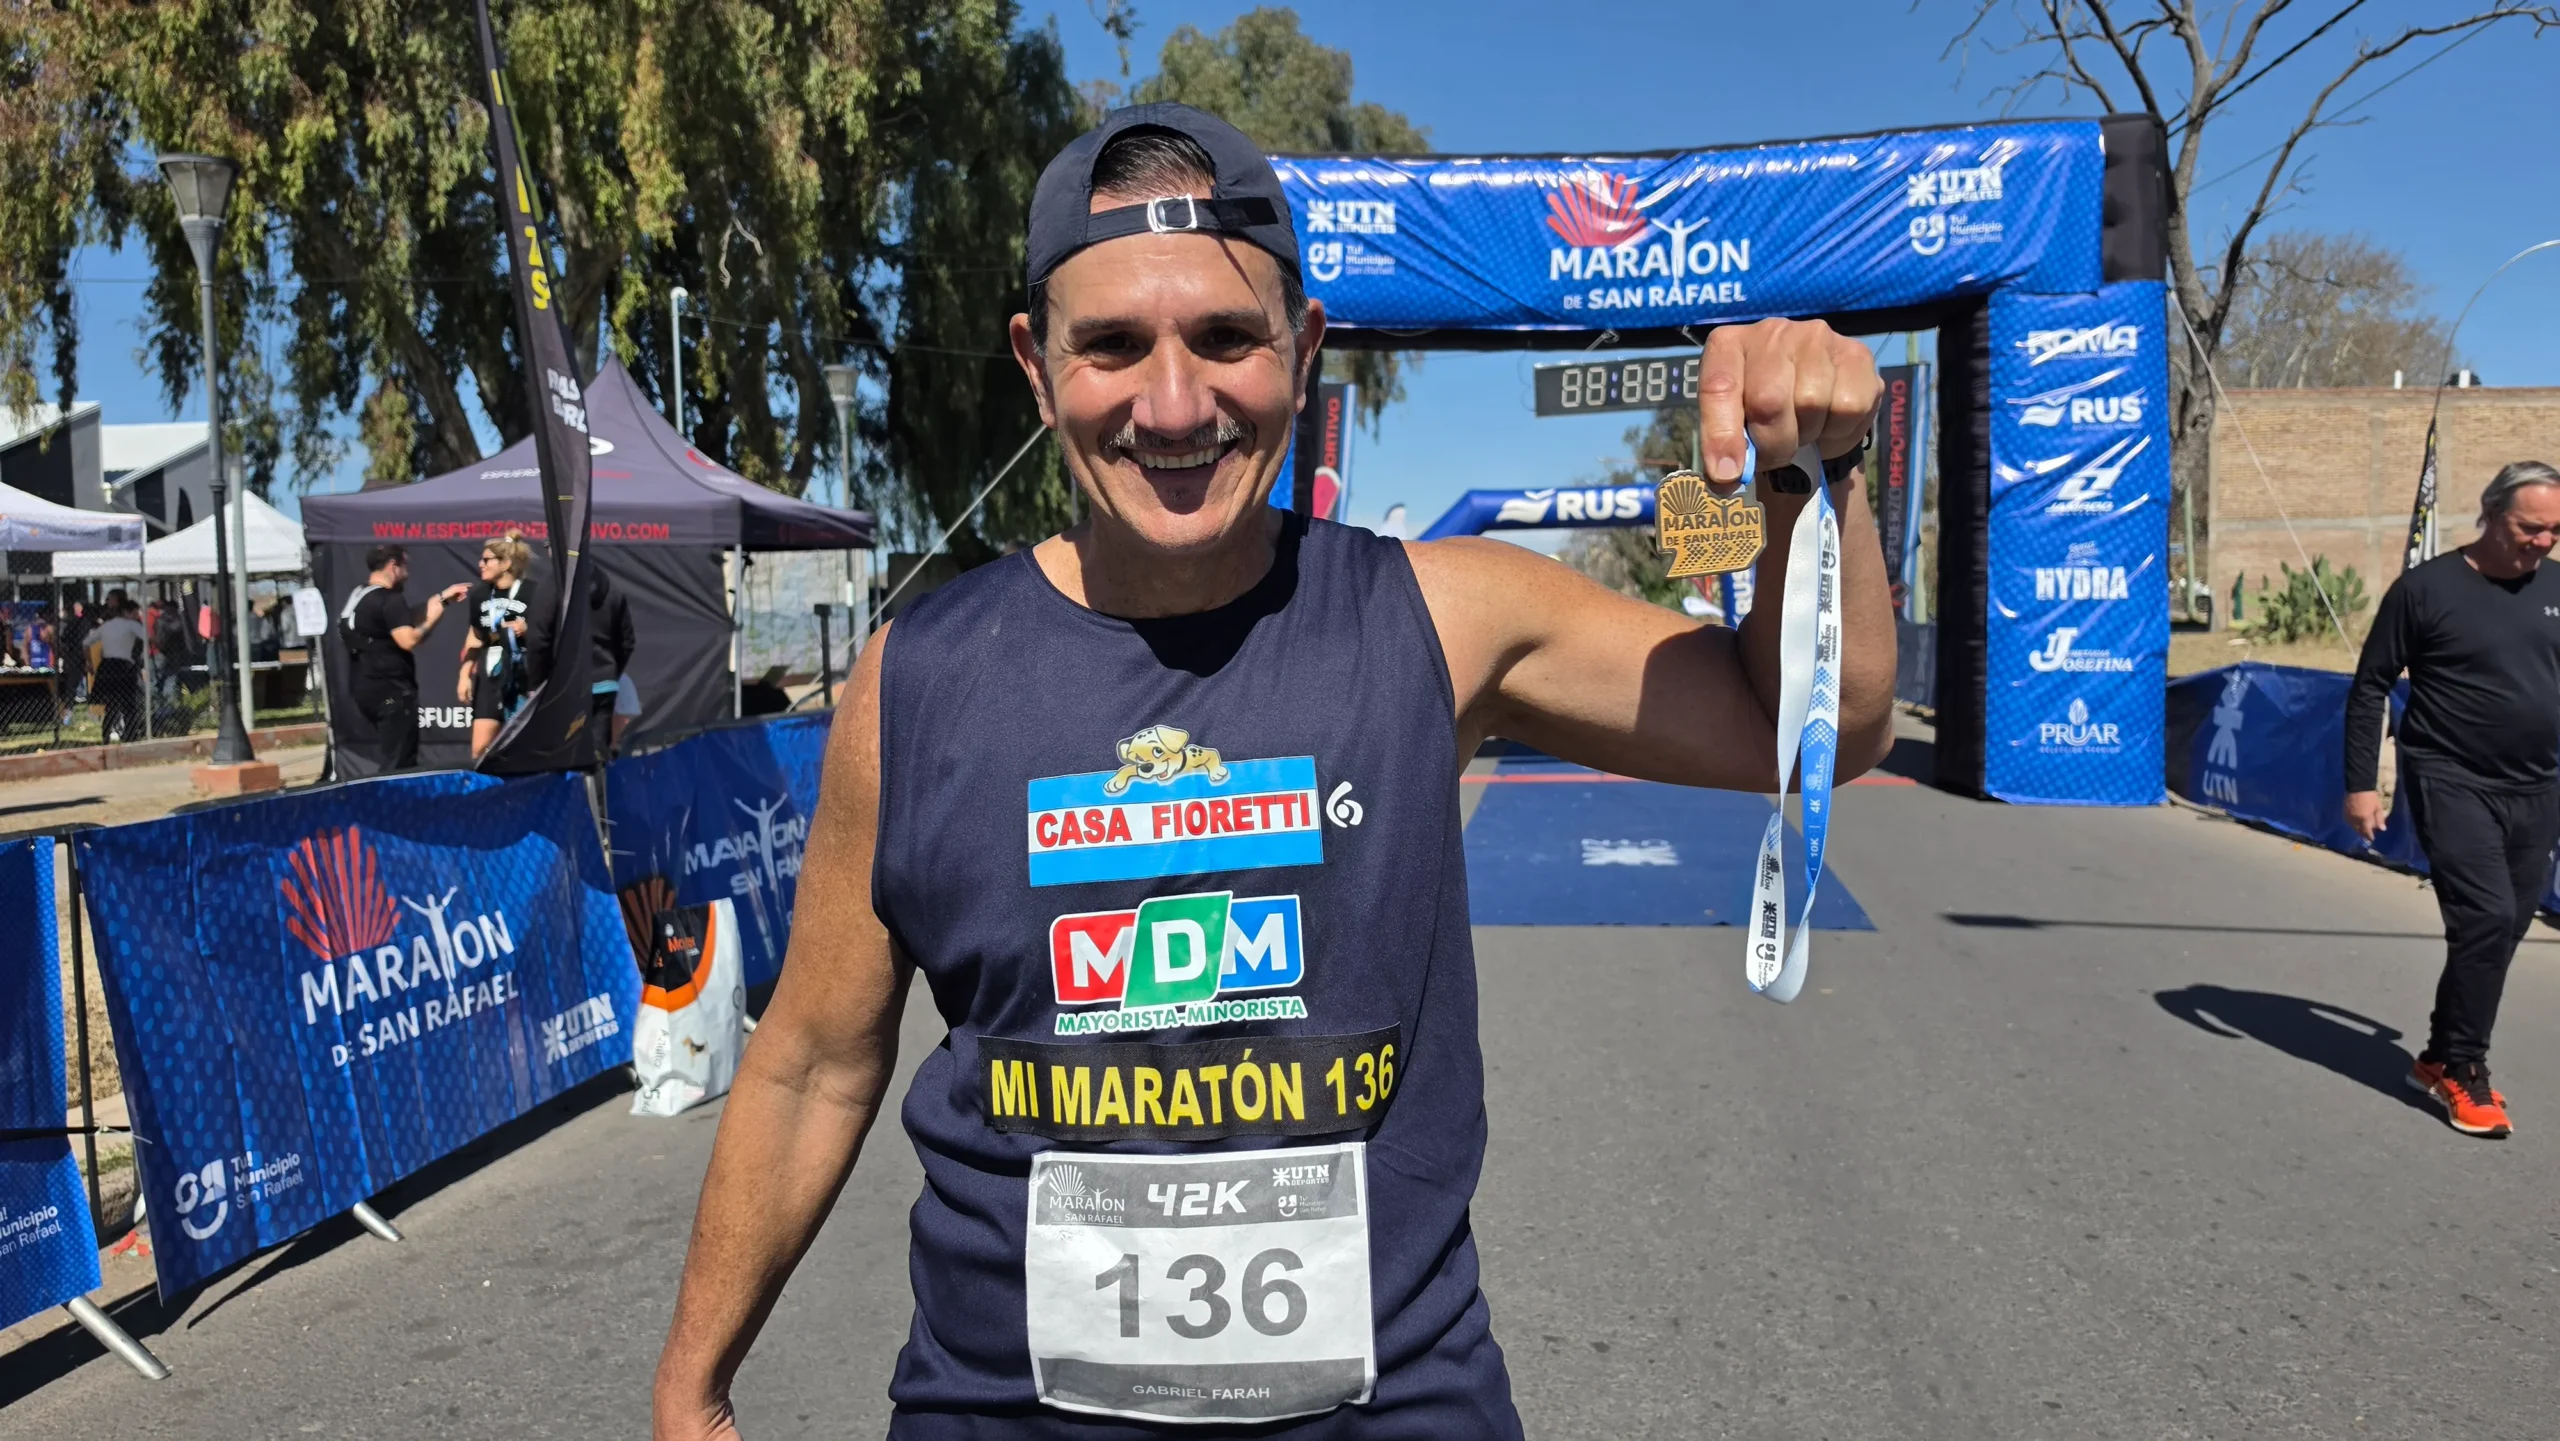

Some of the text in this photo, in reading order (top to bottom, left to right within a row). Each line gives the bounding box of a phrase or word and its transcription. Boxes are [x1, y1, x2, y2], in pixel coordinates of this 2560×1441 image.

[1939, 167, 2003, 192] UTN
[1336, 201, 1396, 224] UTN
[1563, 281, 1747, 309] DE SAN RAFAEL
[2071, 396, 2143, 424] RUS
[1324, 397, 1341, 467] ORTIVO
[1889, 379, 1907, 487] DEPORTIVO
[1557, 488, 1643, 521] RUS
[1666, 530, 1759, 546] DE SAN RAFAEL
[2036, 566, 2129, 600] HYDRA
[2041, 723, 2120, 746] PRUAR
[2203, 770, 2238, 805] UTN
[1036, 793, 1311, 847] CASA FIORETTI
[1810, 799, 1821, 814] 4K
[1811, 838, 1820, 857] 10K
[1070, 913, 1288, 988] MDM
[358, 1007, 420, 1057] SAN
[424, 970, 519, 1032] RAFAEL
[564, 992, 615, 1038] UTN
[1058, 999, 1306, 1032] MAYORISTA-MINORISTA
[991, 1044, 1395, 1126] MI MARATÓN 136
[231, 1151, 253, 1171] Tu!
[233, 1152, 300, 1192] Municipio
[264, 1168, 304, 1196] Rafael
[1148, 1180, 1251, 1217] 42K
[1291, 1164, 1329, 1179] UTN
[1291, 1177, 1330, 1186] DEPORTES
[0, 1205, 58, 1239] unicipio
[1064, 1213, 1086, 1223] SAN
[1086, 1214, 1125, 1224] RAFAEL
[0, 1219, 62, 1257] an Rafael
[1095, 1248, 1307, 1339] 136
[1132, 1385, 1270, 1400] GABRIEL FARAH
